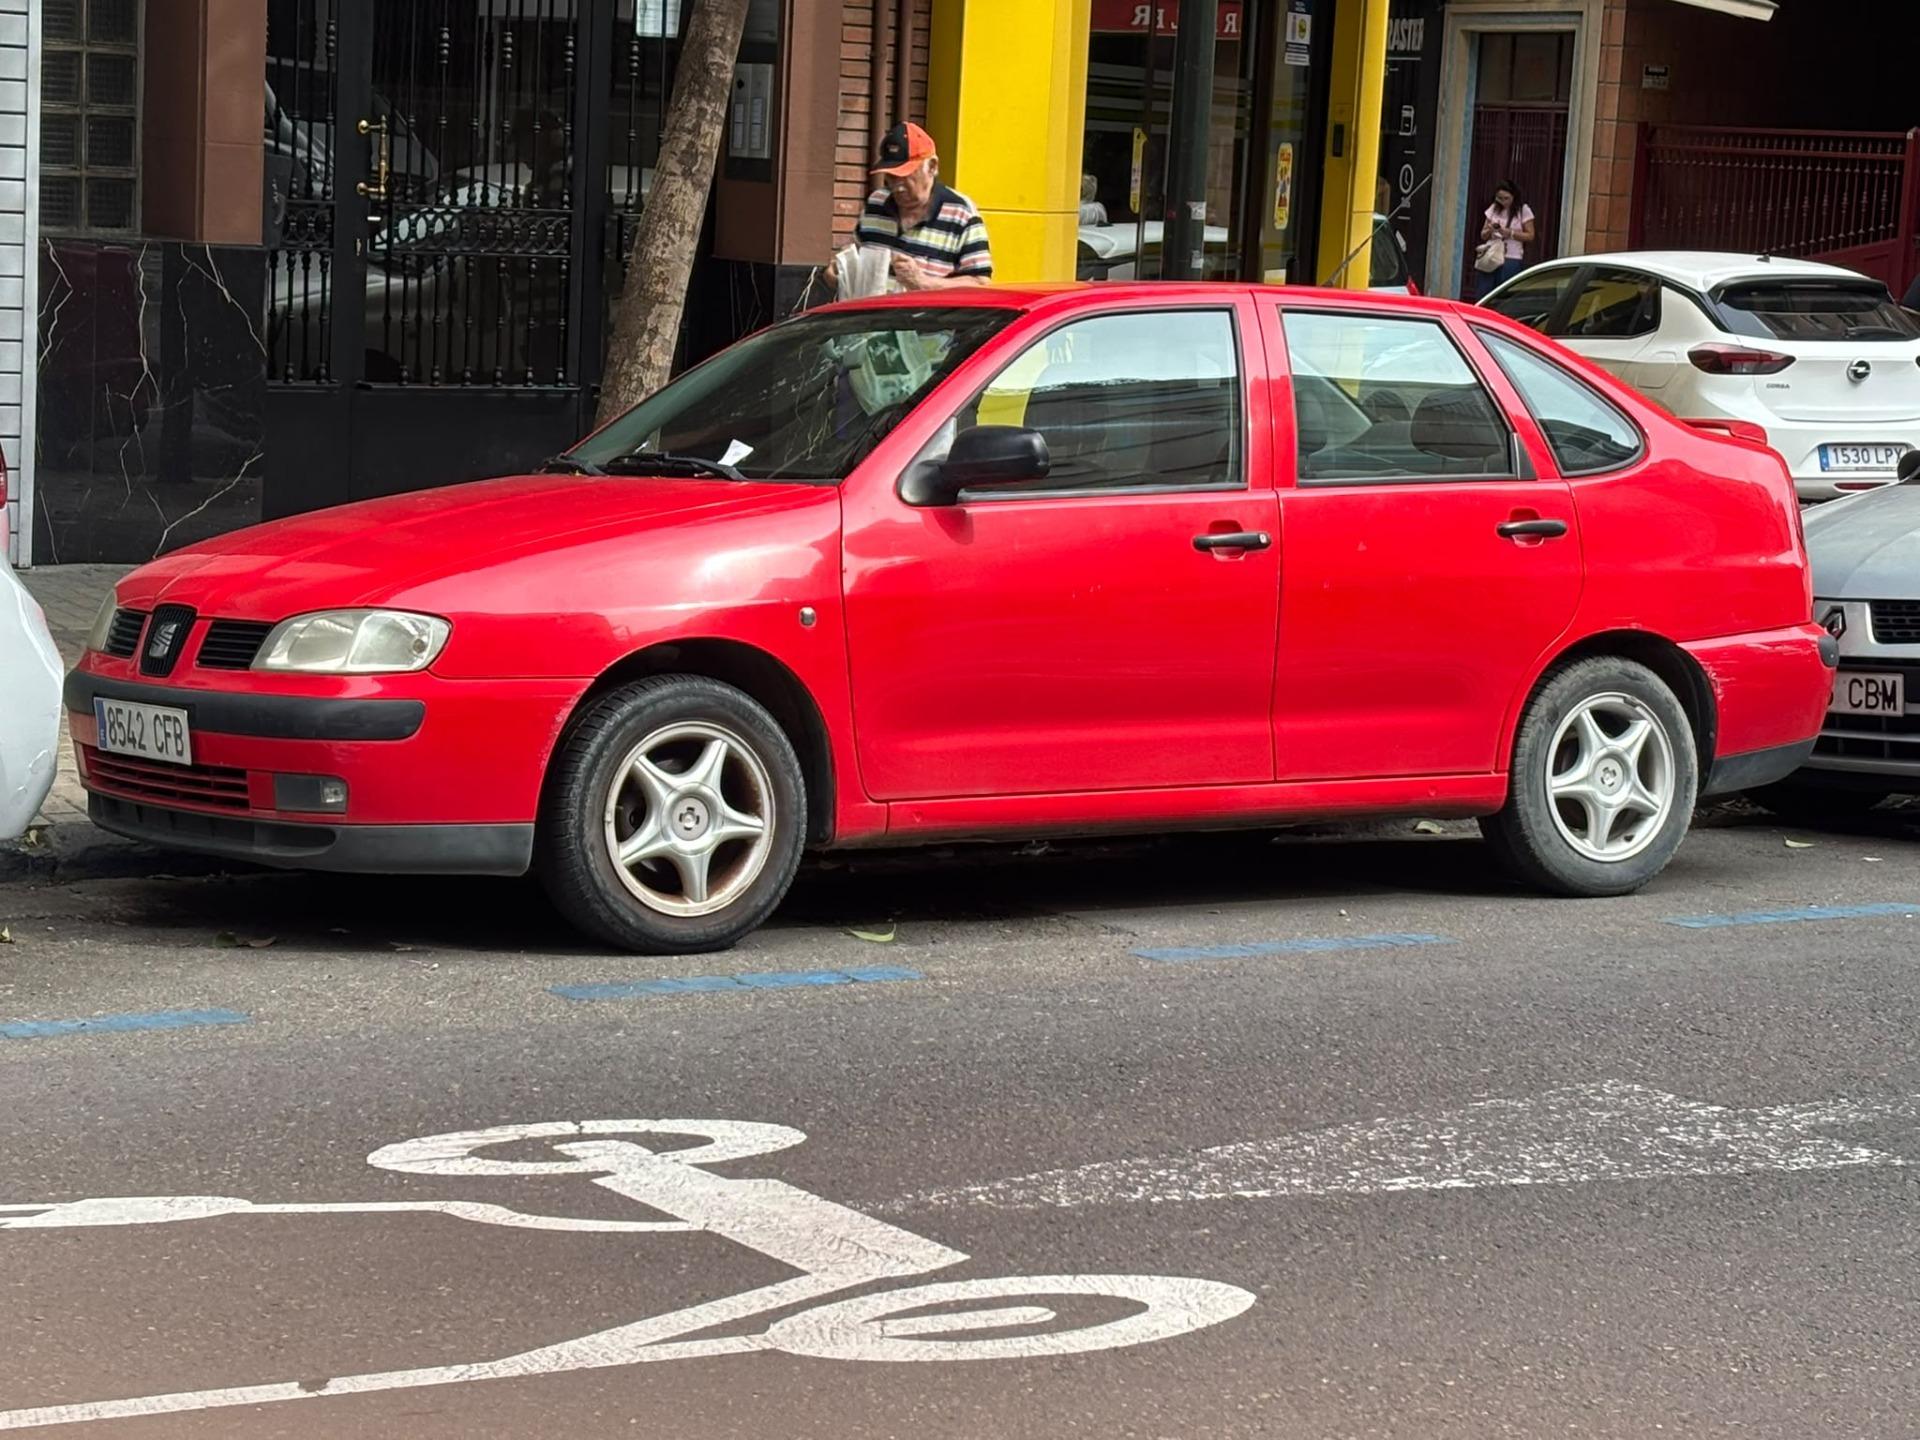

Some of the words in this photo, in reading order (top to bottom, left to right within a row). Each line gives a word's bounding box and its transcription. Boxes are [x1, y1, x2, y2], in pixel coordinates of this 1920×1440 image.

[1833, 447, 1870, 464] 1530
[1875, 447, 1902, 464] LPY
[1848, 678, 1897, 712] CBM
[107, 706, 147, 752] 8542
[153, 713, 184, 757] CFB
